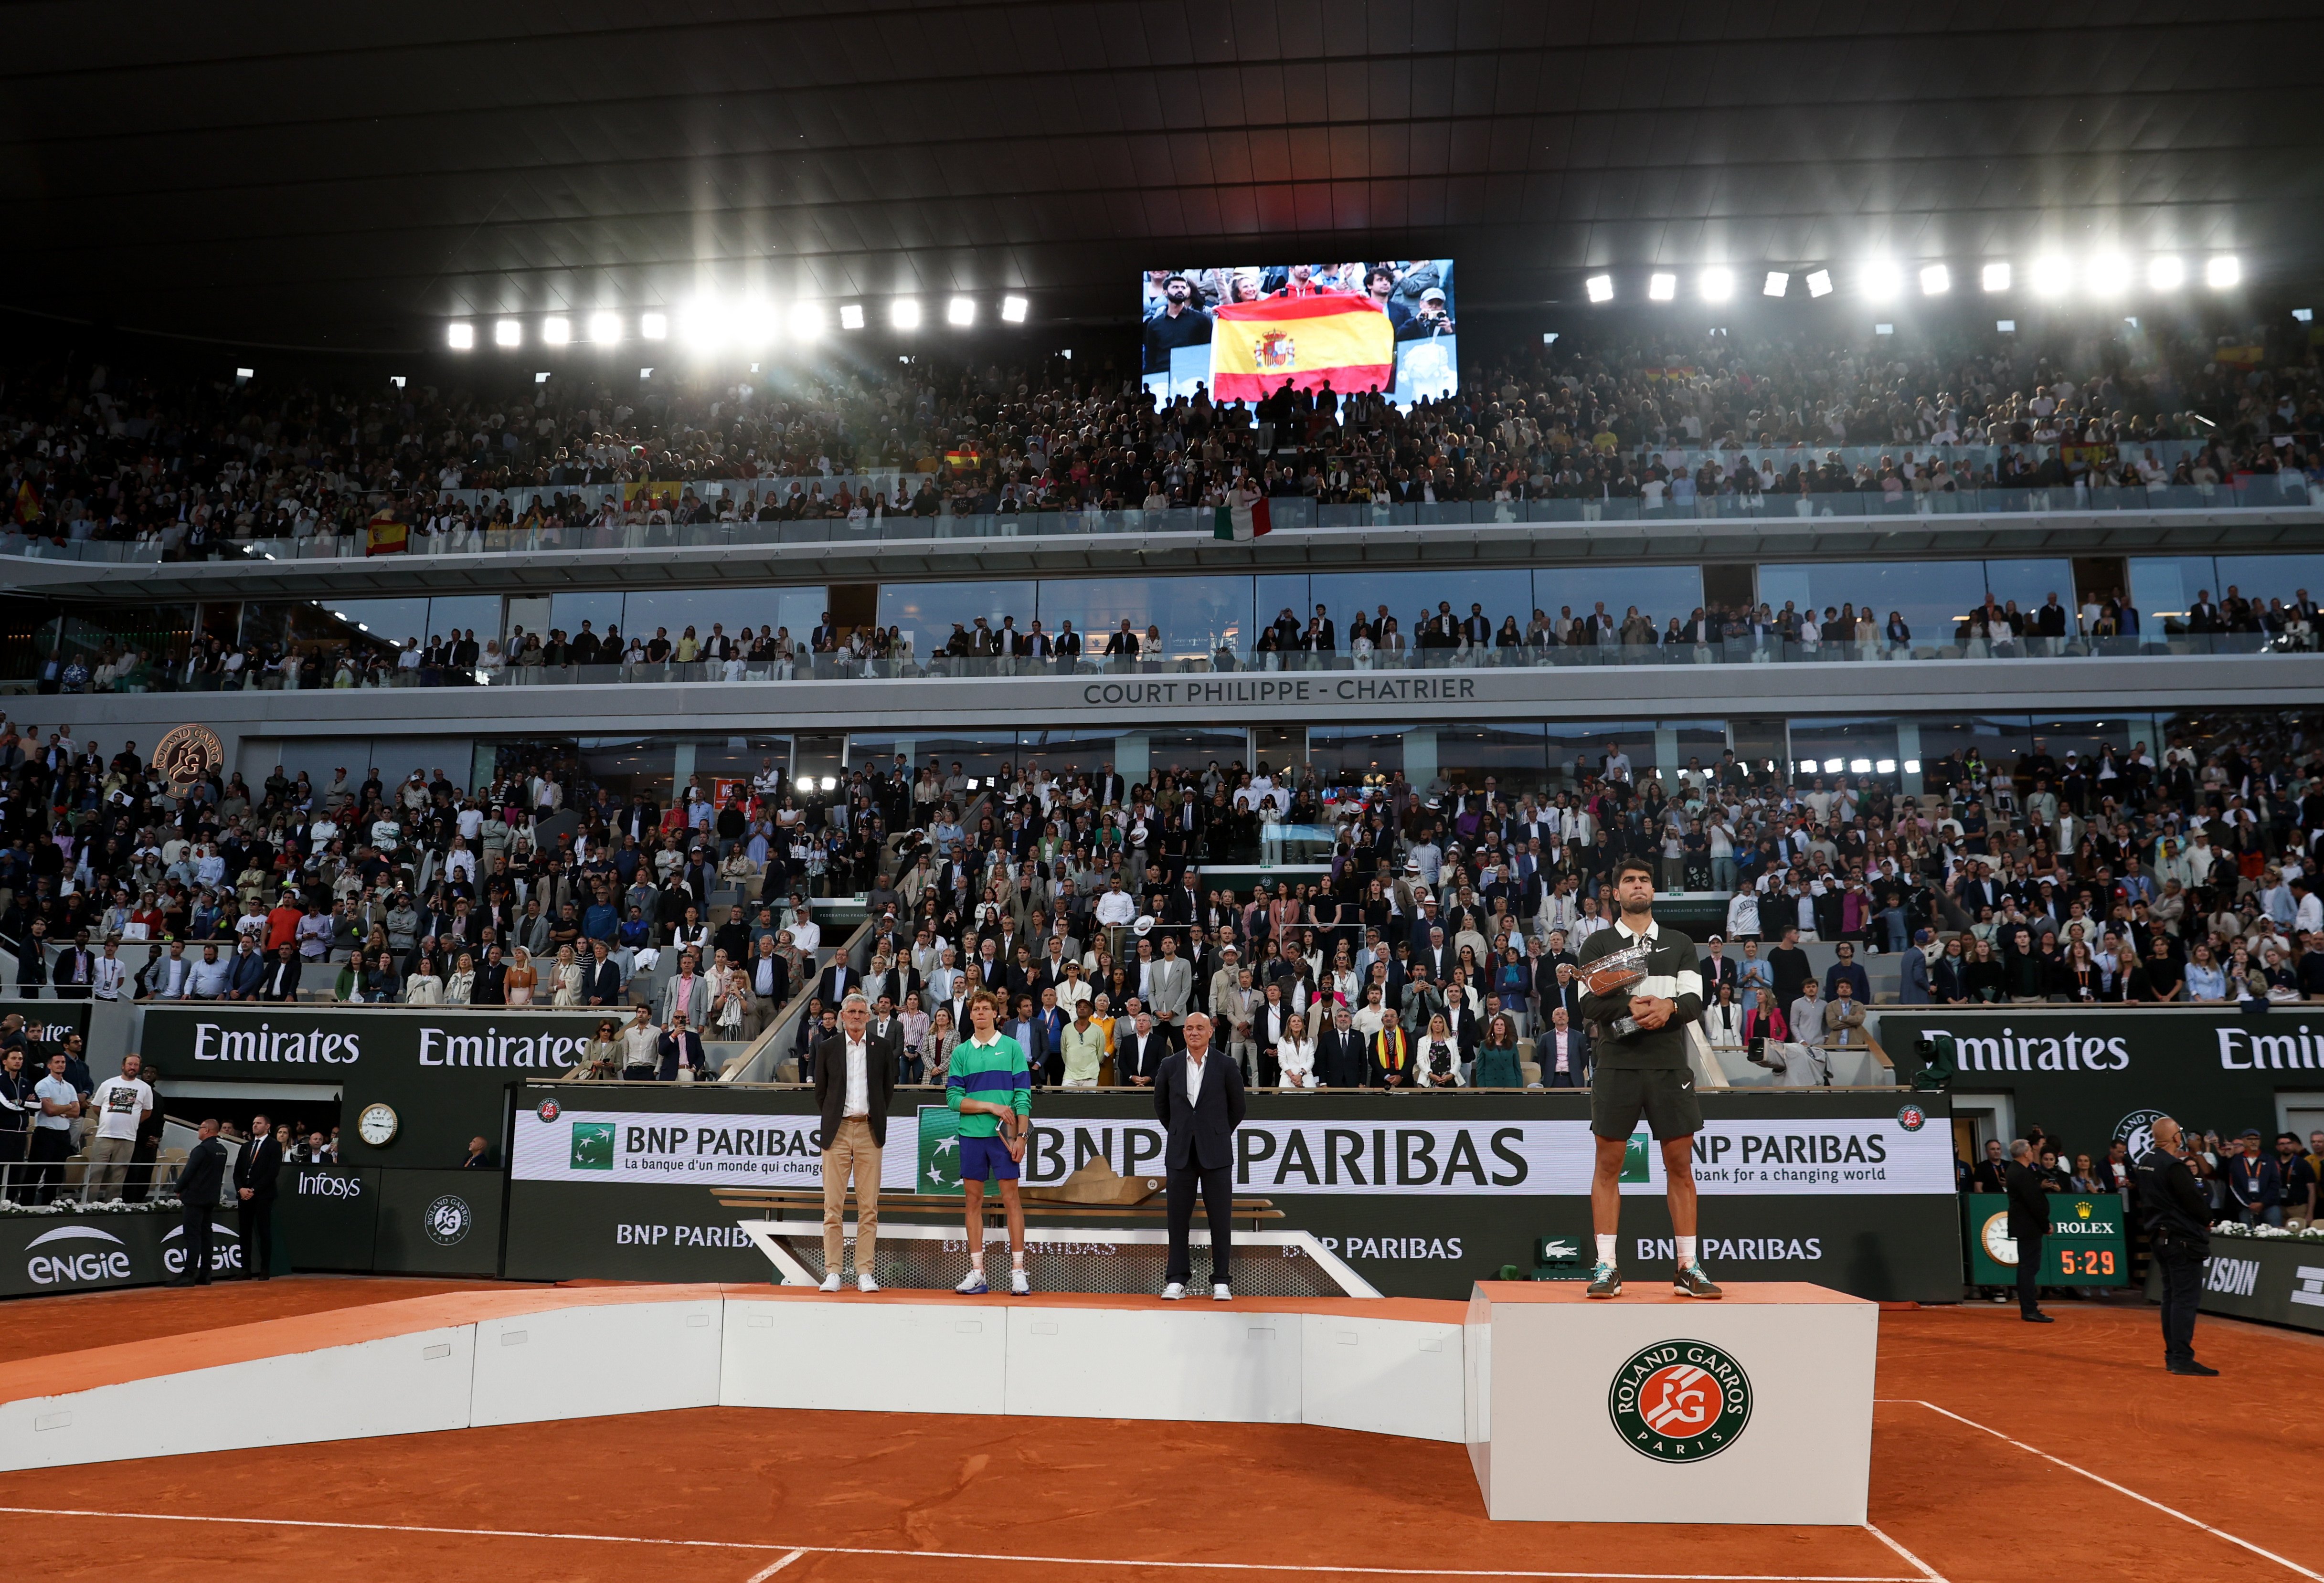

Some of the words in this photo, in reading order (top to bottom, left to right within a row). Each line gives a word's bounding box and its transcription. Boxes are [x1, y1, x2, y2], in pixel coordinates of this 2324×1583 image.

[1084, 684, 1178, 704] COURT
[1187, 681, 1310, 702] PHILIPPE
[1337, 679, 1475, 699] CHATRIER
[157, 729, 190, 769] ROLAND
[194, 729, 220, 762] GARRO
[195, 1023, 359, 1064] Emirates
[626, 1127, 688, 1153] BNP
[2118, 1115, 2146, 1142] LAND
[1026, 1127, 1162, 1181] BNP
[1237, 1128, 1528, 1186] PARIBAS
[1690, 1136, 1731, 1164] NP
[1742, 1134, 1886, 1163] PARIBAS
[625, 1158, 637, 1169] La
[642, 1159, 683, 1172] banque
[688, 1159, 712, 1171] d'un
[718, 1160, 757, 1171] monde
[761, 1161, 779, 1174] qui
[1695, 1169, 1729, 1181] bank
[1733, 1169, 1755, 1183] for
[1761, 1171, 1768, 1181] a
[1773, 1169, 1838, 1183] changing
[1844, 1168, 1886, 1180] world
[298, 1172, 360, 1199] Infosys
[427, 1198, 448, 1225] ROLAND
[451, 1199, 468, 1226] GARROS
[433, 1232, 460, 1241] PARIS
[617, 1224, 668, 1245] BNP
[674, 1225, 755, 1248] PARIB
[2056, 1222, 2115, 1234] ROLEX
[1347, 1237, 1463, 1259] PARIBAS
[1637, 1238, 1677, 1260] BN
[1702, 1238, 1822, 1260] PARIBAS
[2061, 1250, 2115, 1275] 5:29
[2207, 1257, 2260, 1296] ISDIN
[1618, 1347, 1677, 1414] ROLAND
[1687, 1347, 1744, 1414] GARROS
[1636, 1431, 1722, 1454] PARIS
